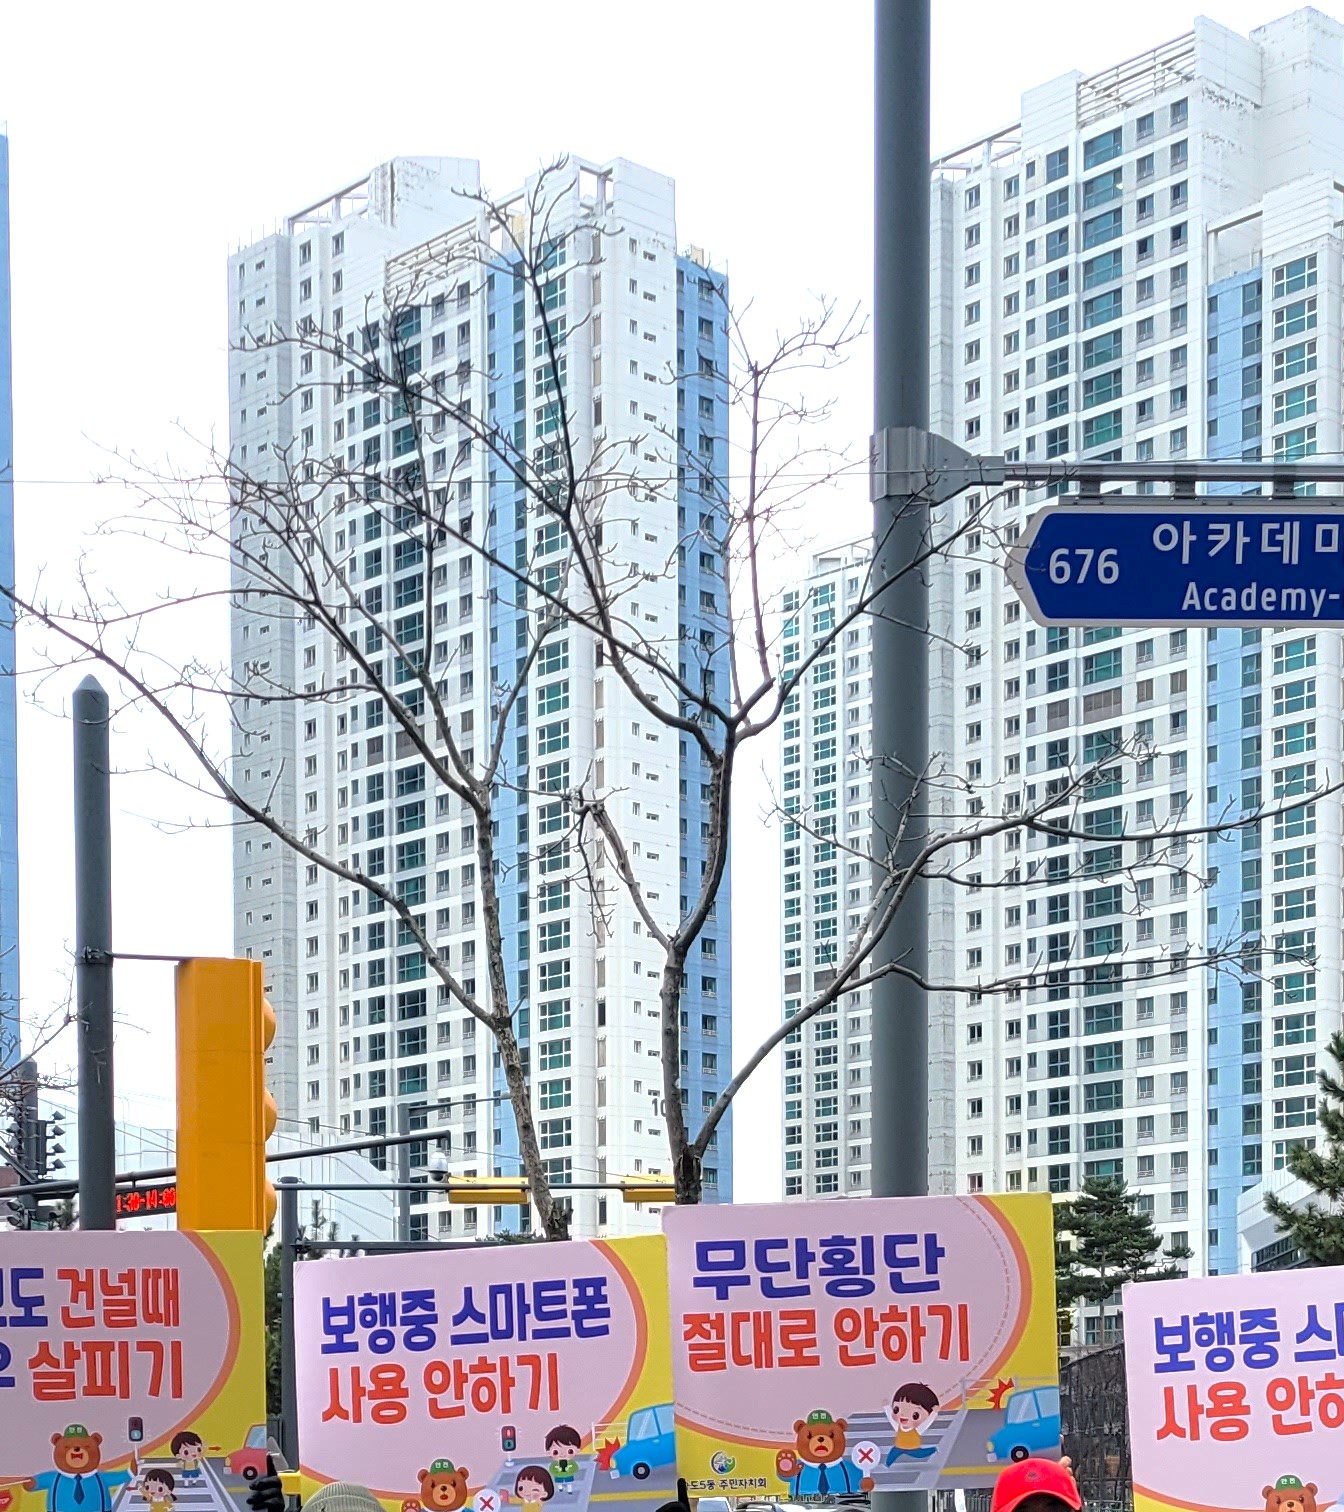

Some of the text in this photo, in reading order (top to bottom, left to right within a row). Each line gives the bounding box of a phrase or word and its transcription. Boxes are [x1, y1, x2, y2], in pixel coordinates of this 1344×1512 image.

[1048, 548, 1120, 585] 676
[57, 1268, 181, 1328] 건널때
[692, 1232, 947, 1300] 무단횡단
[320, 1275, 612, 1355] 보행중 스마트폰
[682, 1304, 971, 1374] 절대로 안하기
[1153, 1307, 1281, 1375] 보행중
[27, 1339, 183, 1401] 살피기
[321, 1352, 560, 1426] 사용 안하기
[1156, 1381, 1251, 1443] 사용
[719, 1478, 767, 1490] 주민자치회
